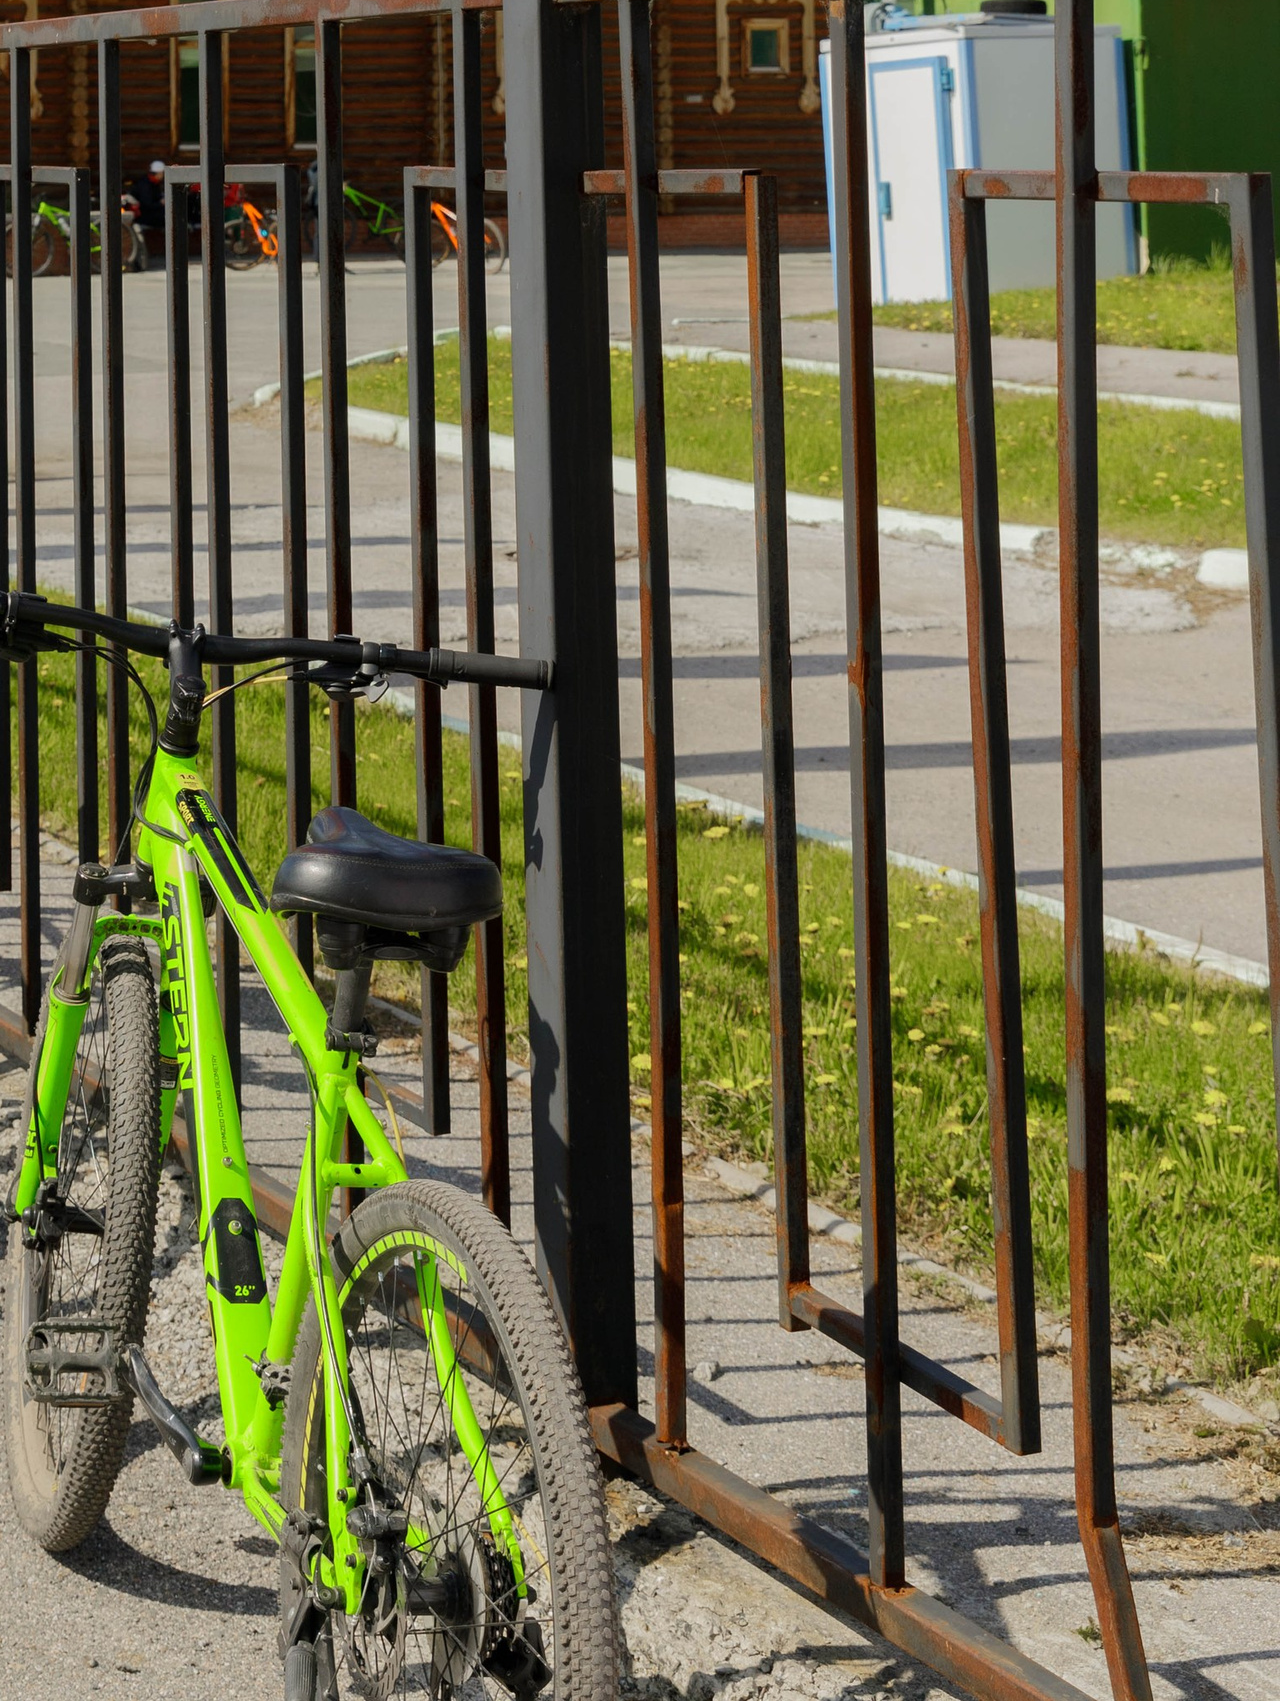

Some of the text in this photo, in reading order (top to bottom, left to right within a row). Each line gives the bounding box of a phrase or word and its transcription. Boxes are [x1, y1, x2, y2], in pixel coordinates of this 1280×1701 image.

[178, 801, 195, 827] SPORT
[194, 794, 217, 823] ENERGY
[162, 913, 195, 1091] STERN
[211, 1054, 228, 1154] OPTIMIZED CYCLING GEOMETRY
